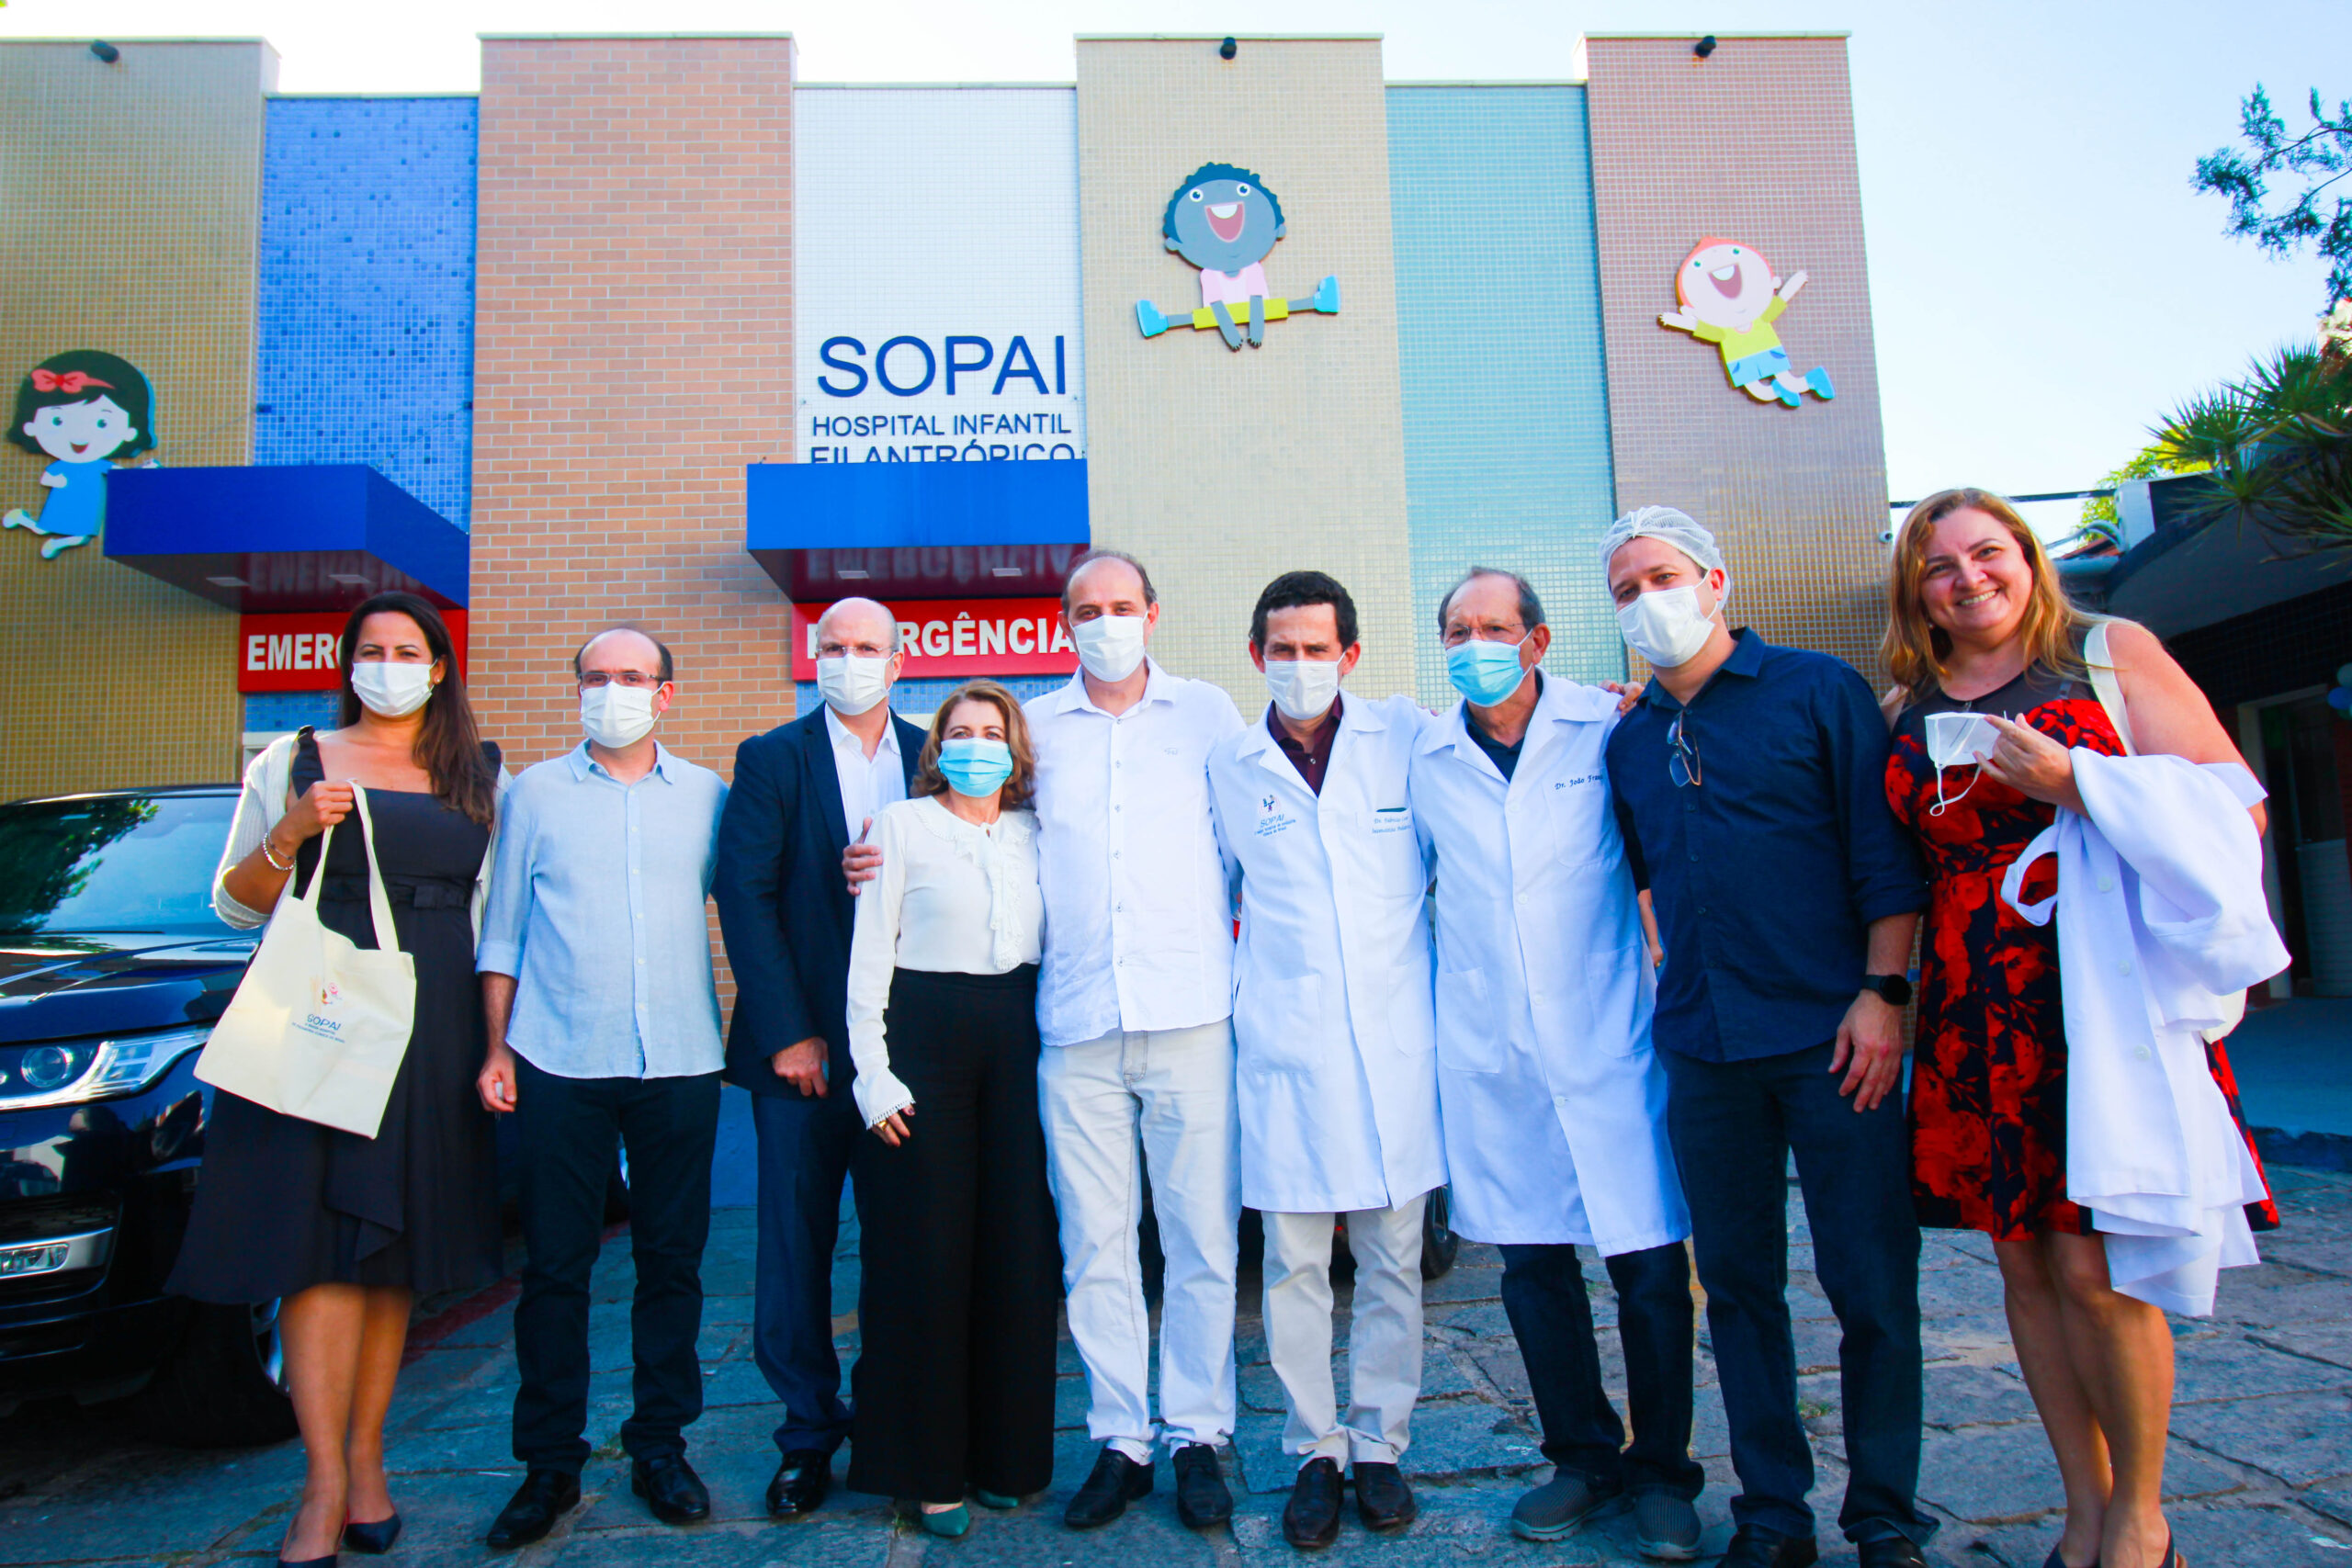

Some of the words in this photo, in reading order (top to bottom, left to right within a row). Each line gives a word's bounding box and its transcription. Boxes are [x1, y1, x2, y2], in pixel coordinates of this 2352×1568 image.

[817, 335, 1066, 398] SOPAI
[813, 414, 945, 437] HOSPITAL
[953, 412, 1072, 435] INFANTIL
[247, 633, 344, 671] EMER
[307, 1013, 341, 1031] SOPAI
